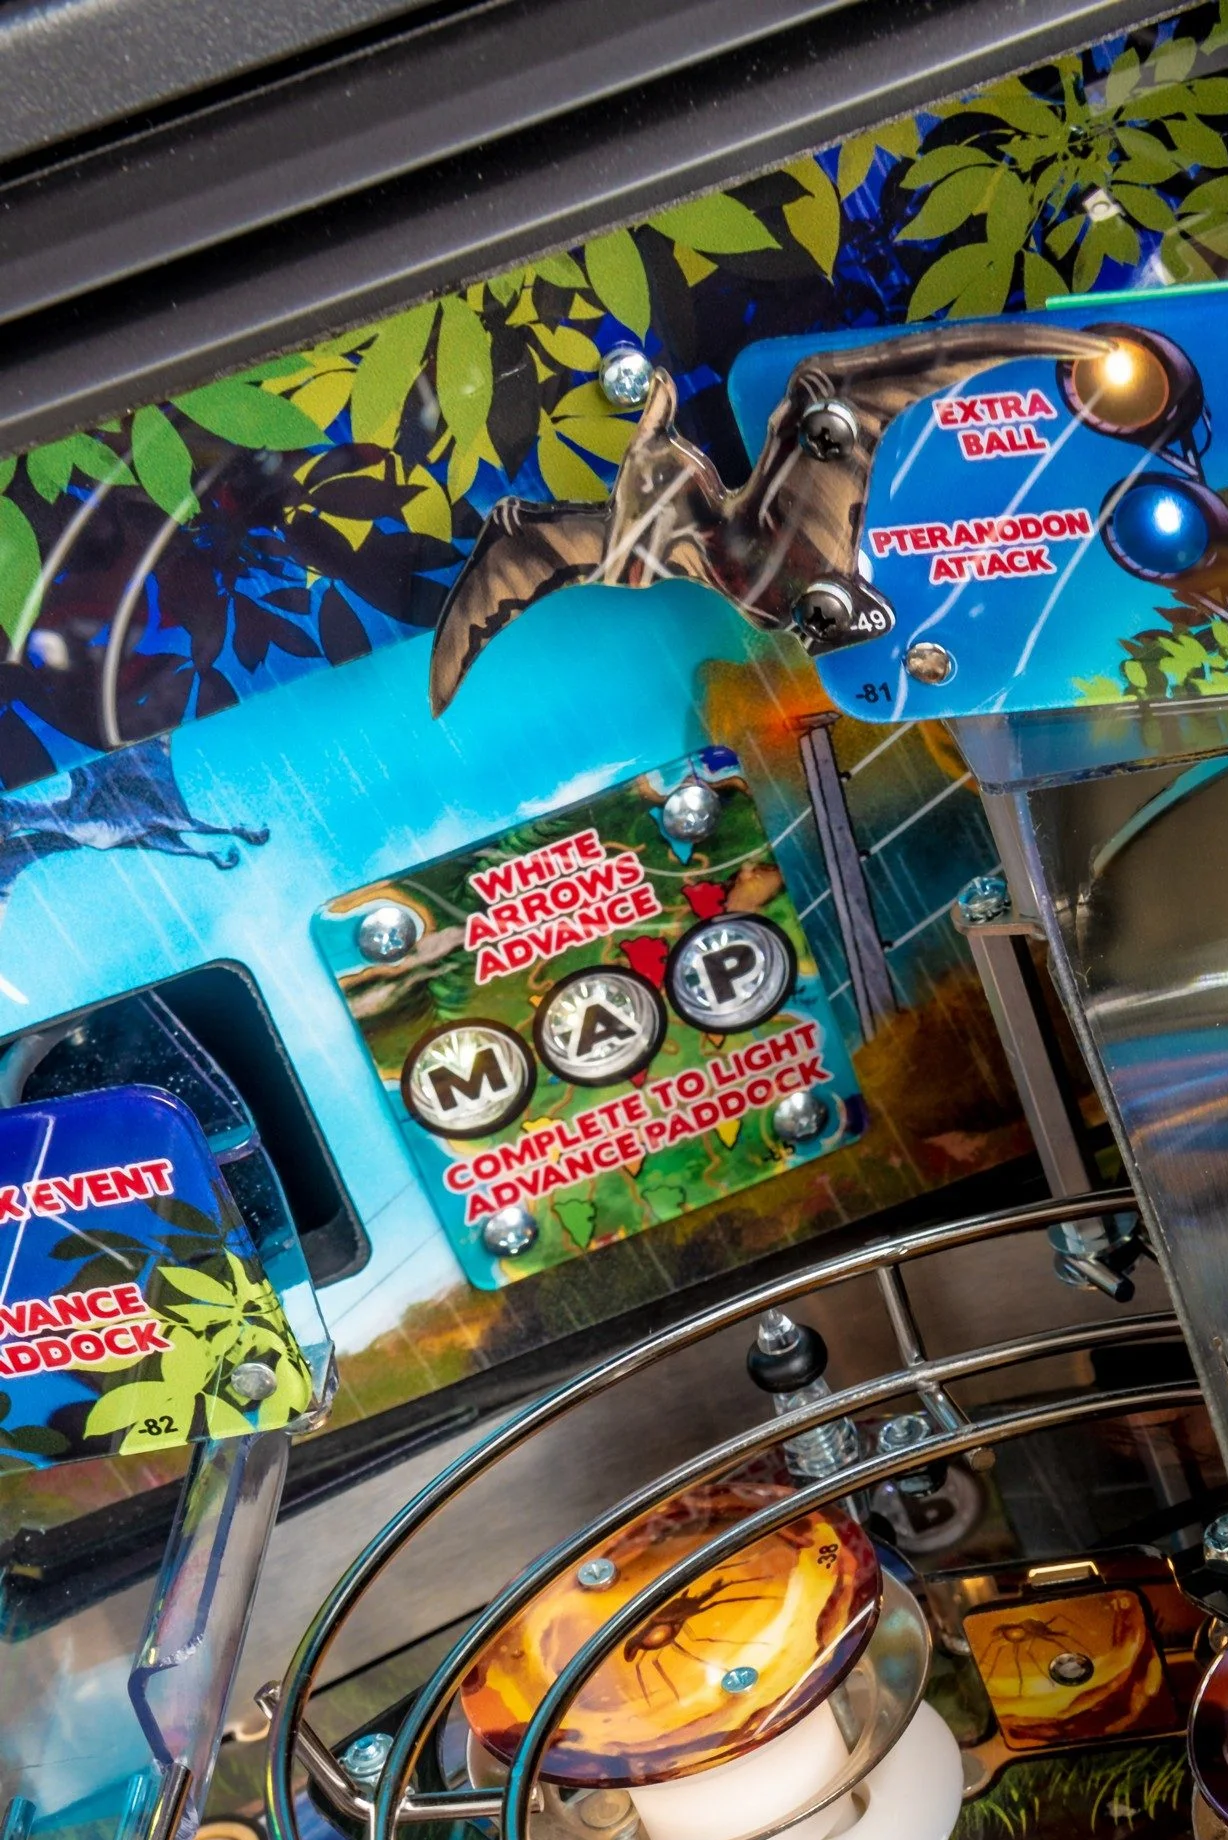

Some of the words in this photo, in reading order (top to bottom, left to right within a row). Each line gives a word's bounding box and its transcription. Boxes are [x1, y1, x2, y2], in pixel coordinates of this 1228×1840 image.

[934, 391, 1056, 427] EXTRA
[960, 424, 1048, 459] BALL
[870, 509, 1093, 556] PTERANODON
[930, 547, 1054, 583] ATTACK
[850, 609, 887, 632] -49
[855, 682, 893, 704] -81
[472, 829, 605, 904] WHITE
[465, 853, 644, 950] ARROWS
[476, 883, 662, 983] ADVANCE
[426, 1045, 510, 1113] M
[575, 1001, 639, 1058] A
[699, 942, 759, 1006] P
[446, 1090, 650, 1194] COMPLETE
[650, 1067, 709, 1108] TO
[713, 1022, 820, 1088] LIGHT
[466, 1138, 643, 1223] ADVANCE
[643, 1057, 832, 1150] PADDOCK
[30, 1160, 170, 1213] EVENT
[0, 1285, 146, 1335] VANCE
[138, 1416, 178, 1436] -82
